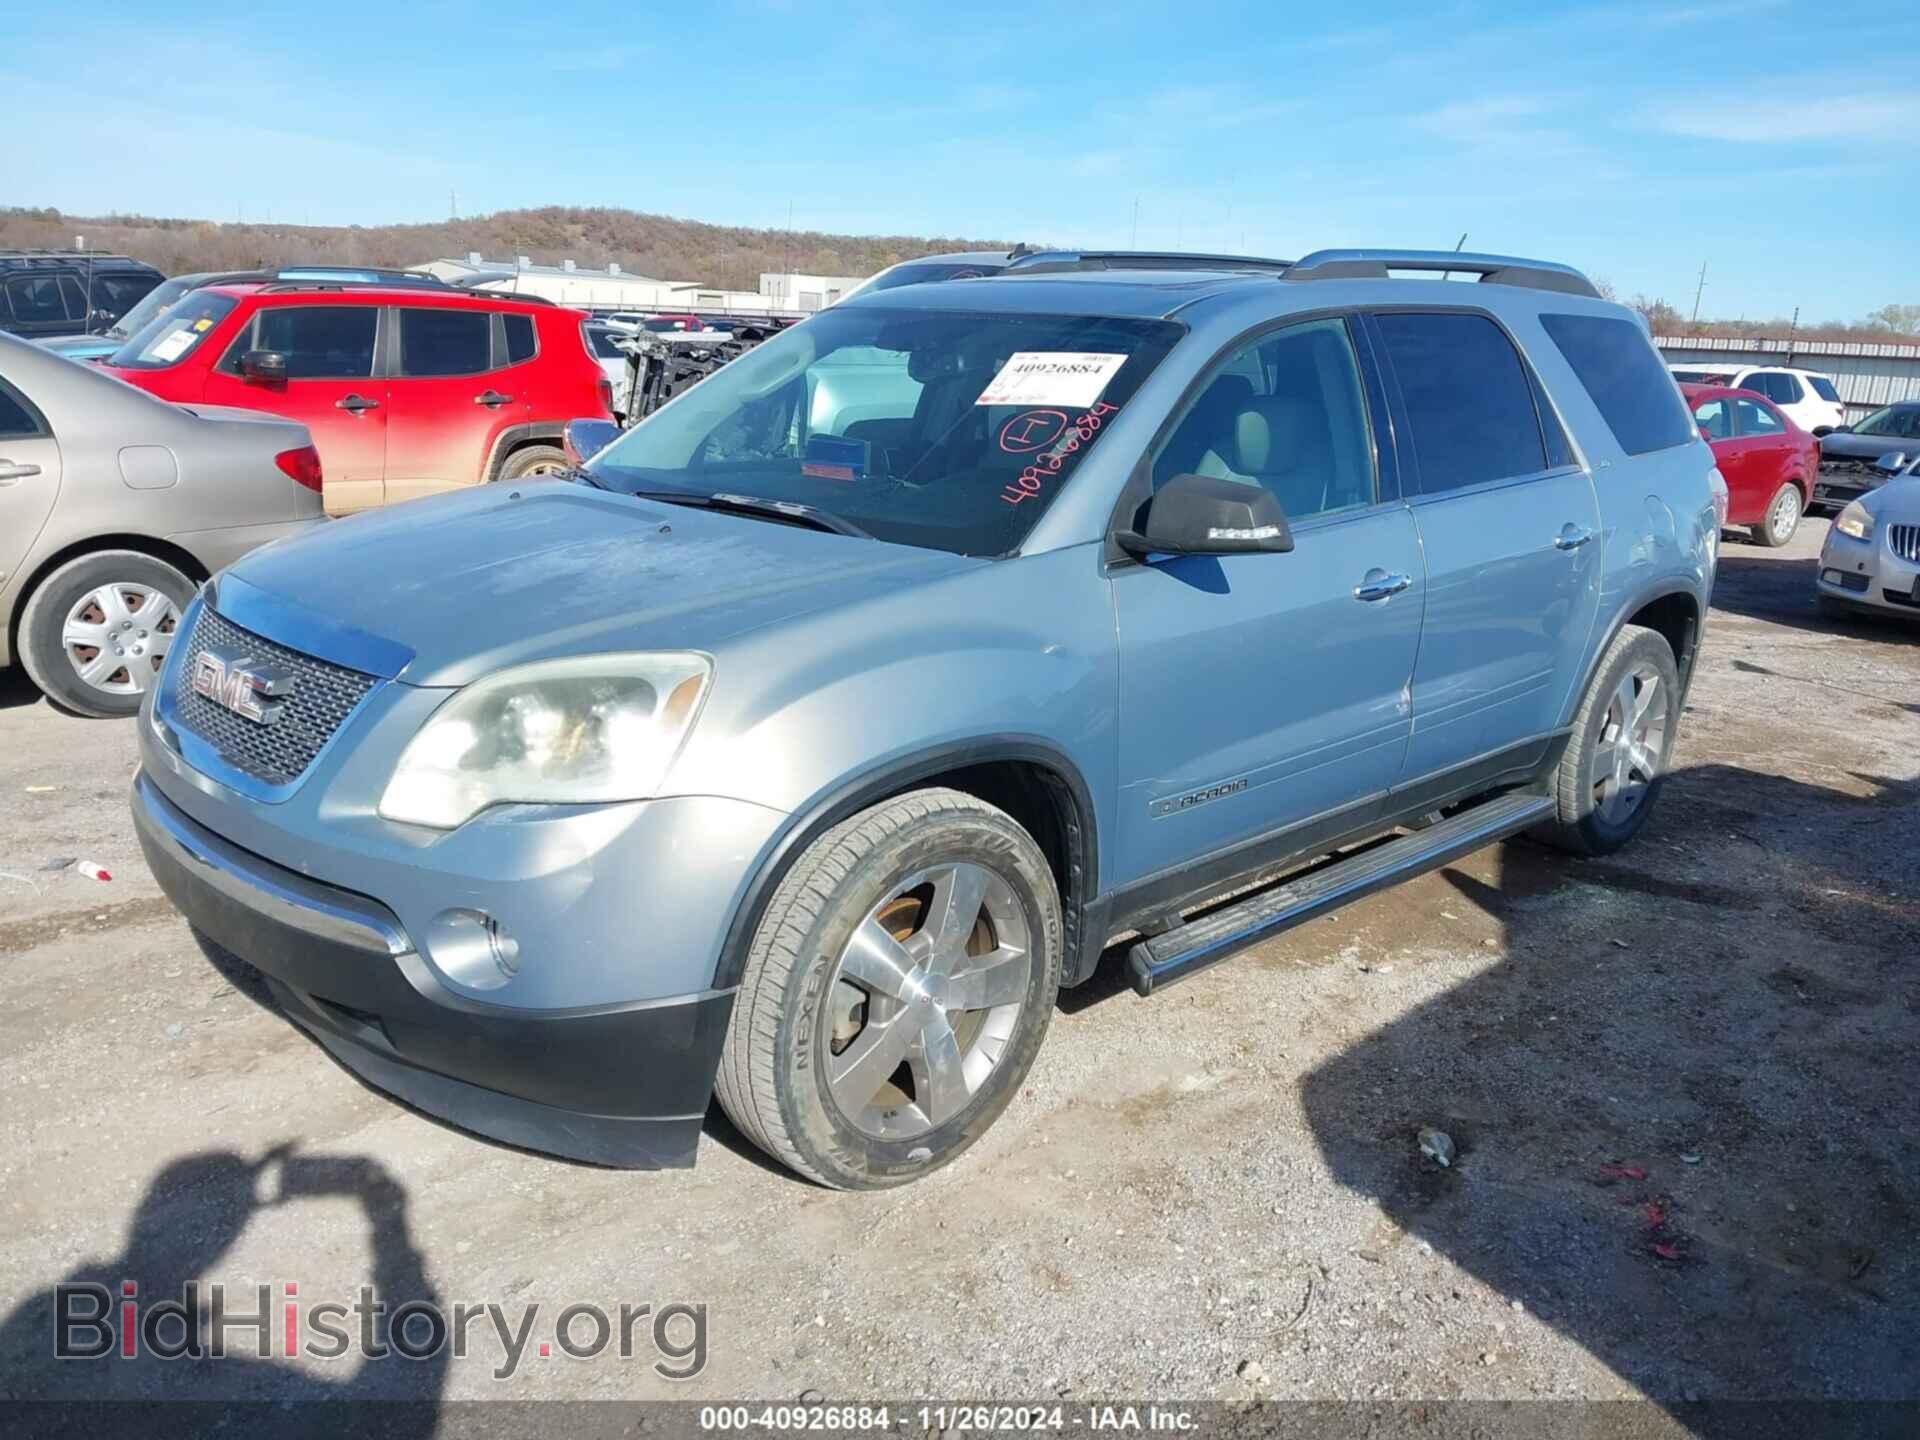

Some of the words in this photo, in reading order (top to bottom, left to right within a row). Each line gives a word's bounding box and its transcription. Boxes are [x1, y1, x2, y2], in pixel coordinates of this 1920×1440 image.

[1013, 363, 1102, 374] 40926884
[1000, 401, 1119, 503] 40926884
[192, 651, 275, 722] GMC
[796, 955, 831, 1070] NEXEN
